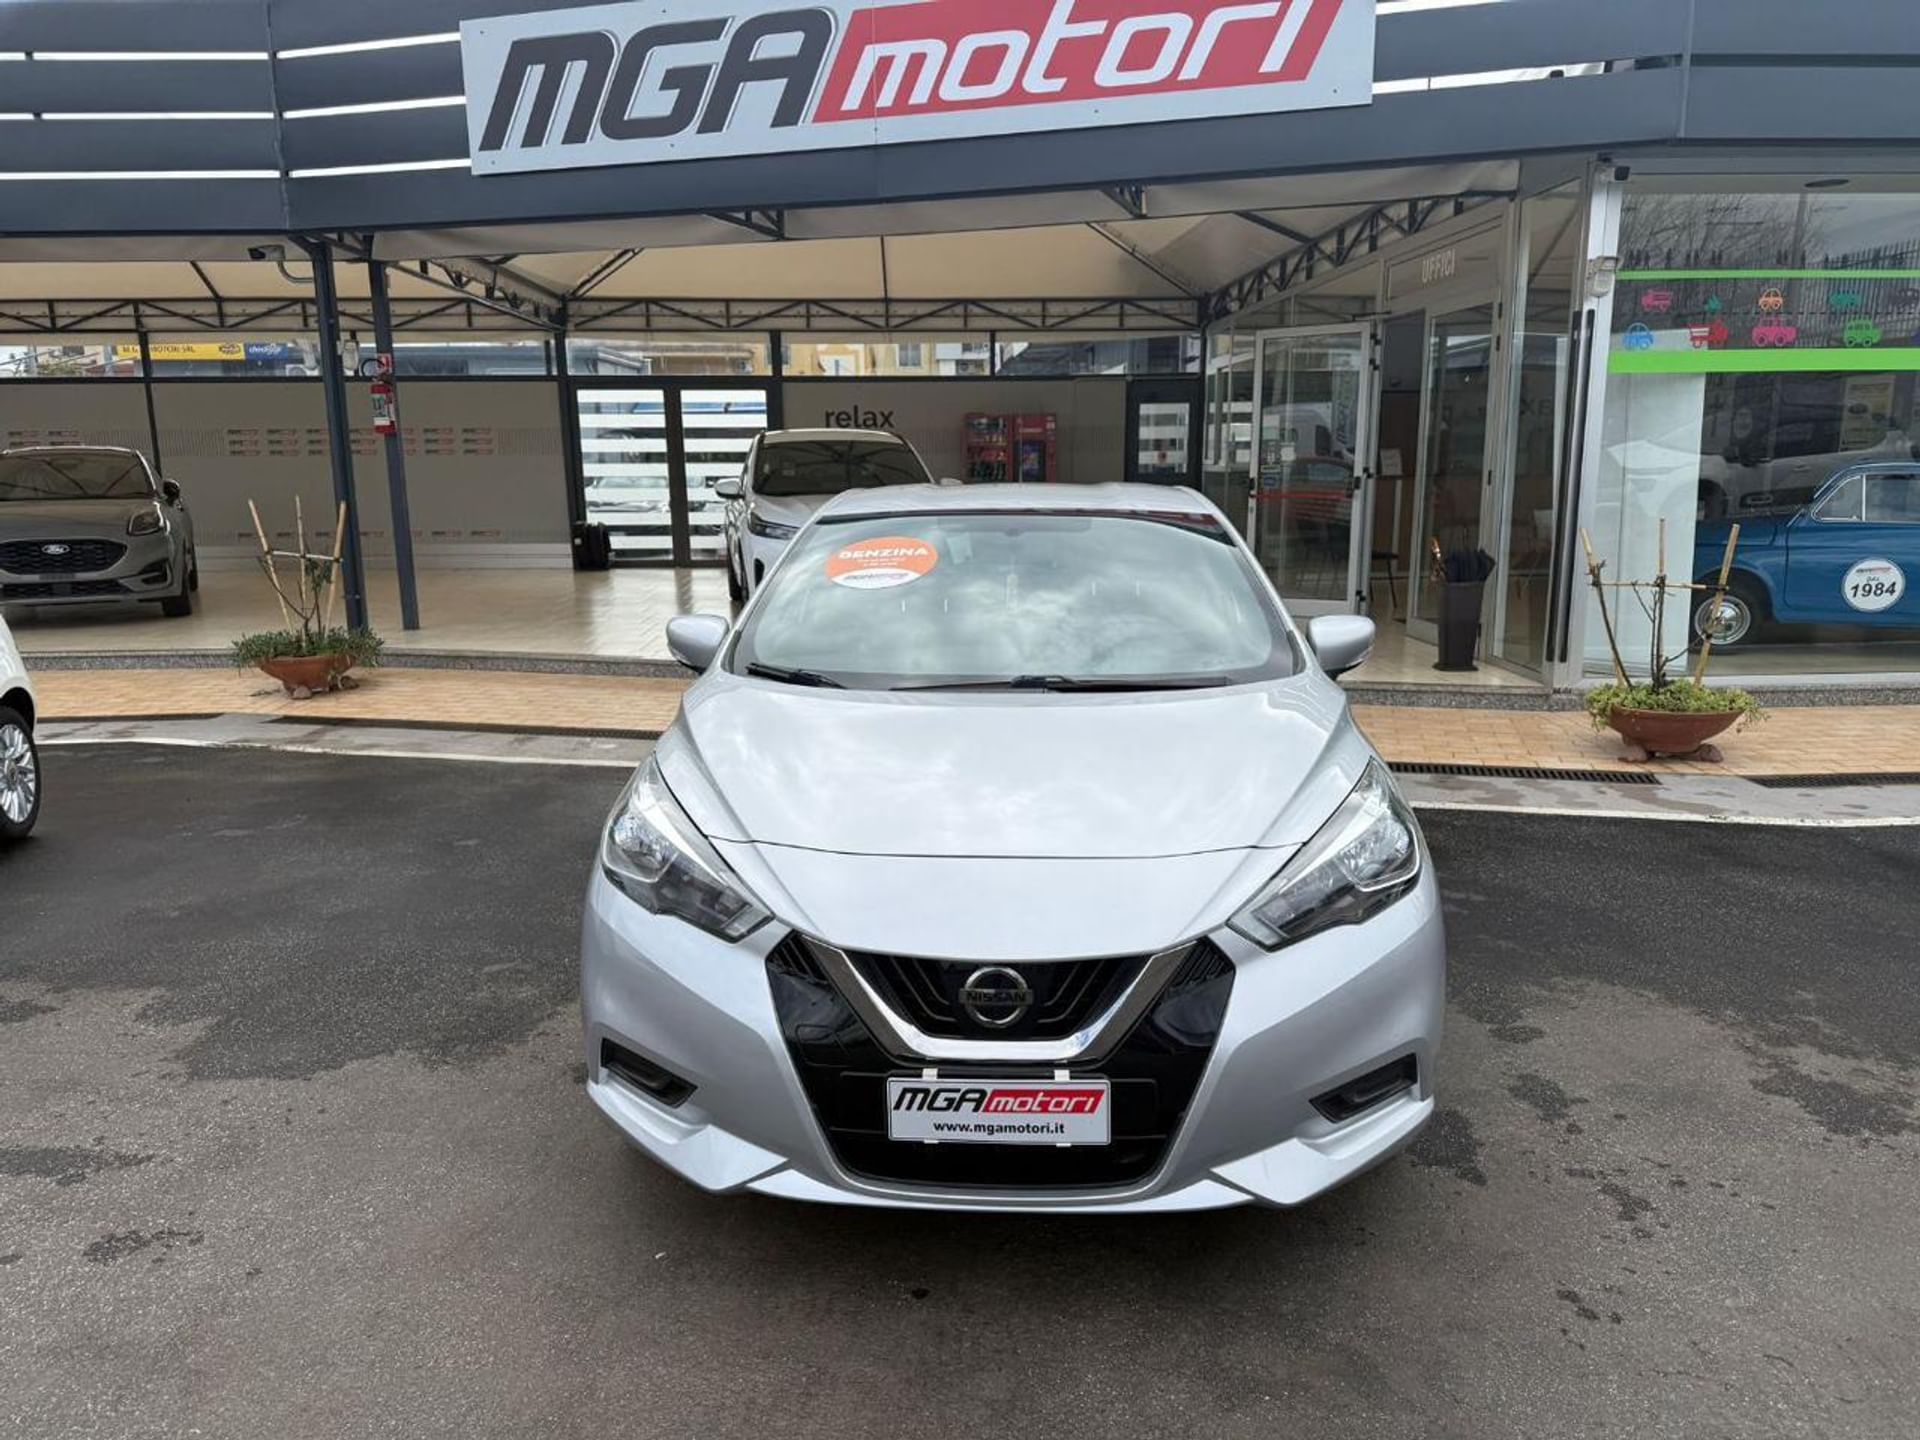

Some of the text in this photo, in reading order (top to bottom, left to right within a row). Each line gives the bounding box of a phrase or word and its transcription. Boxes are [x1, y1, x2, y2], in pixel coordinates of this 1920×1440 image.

[1421, 248, 1456, 283] UFFICI
[825, 404, 894, 429] relax
[839, 547, 929, 560] BENZINA
[1850, 581, 1897, 599] 1984
[966, 990, 1027, 1003] NISSAN
[933, 1121, 1065, 1135] www.mgamotori.it
